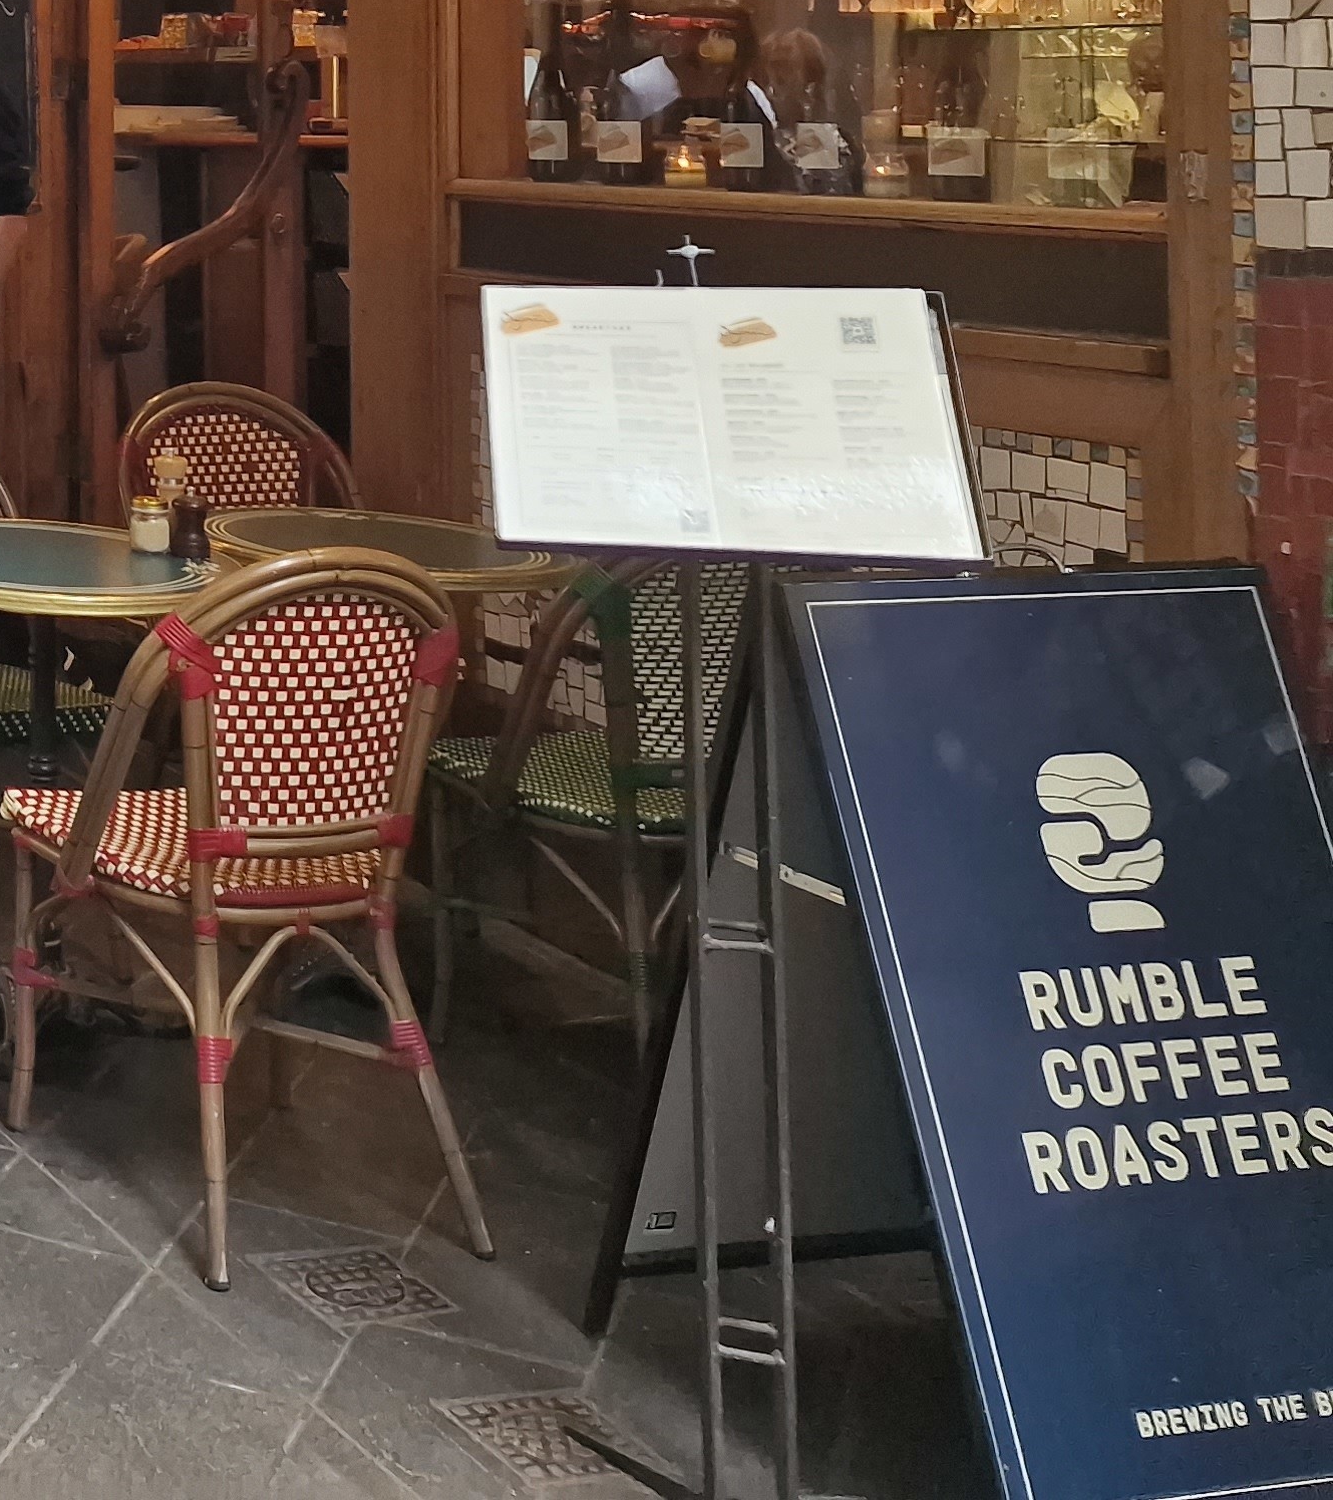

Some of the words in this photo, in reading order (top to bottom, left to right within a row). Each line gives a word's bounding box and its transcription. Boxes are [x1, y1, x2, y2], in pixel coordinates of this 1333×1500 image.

[1019, 955, 1268, 1031] RUMBLE
[1041, 1032, 1290, 1109] COFFEE
[1021, 1107, 1333, 1194] ROASTERS
[1135, 1401, 1250, 1439] BREWING
[1257, 1394, 1308, 1423] THE
